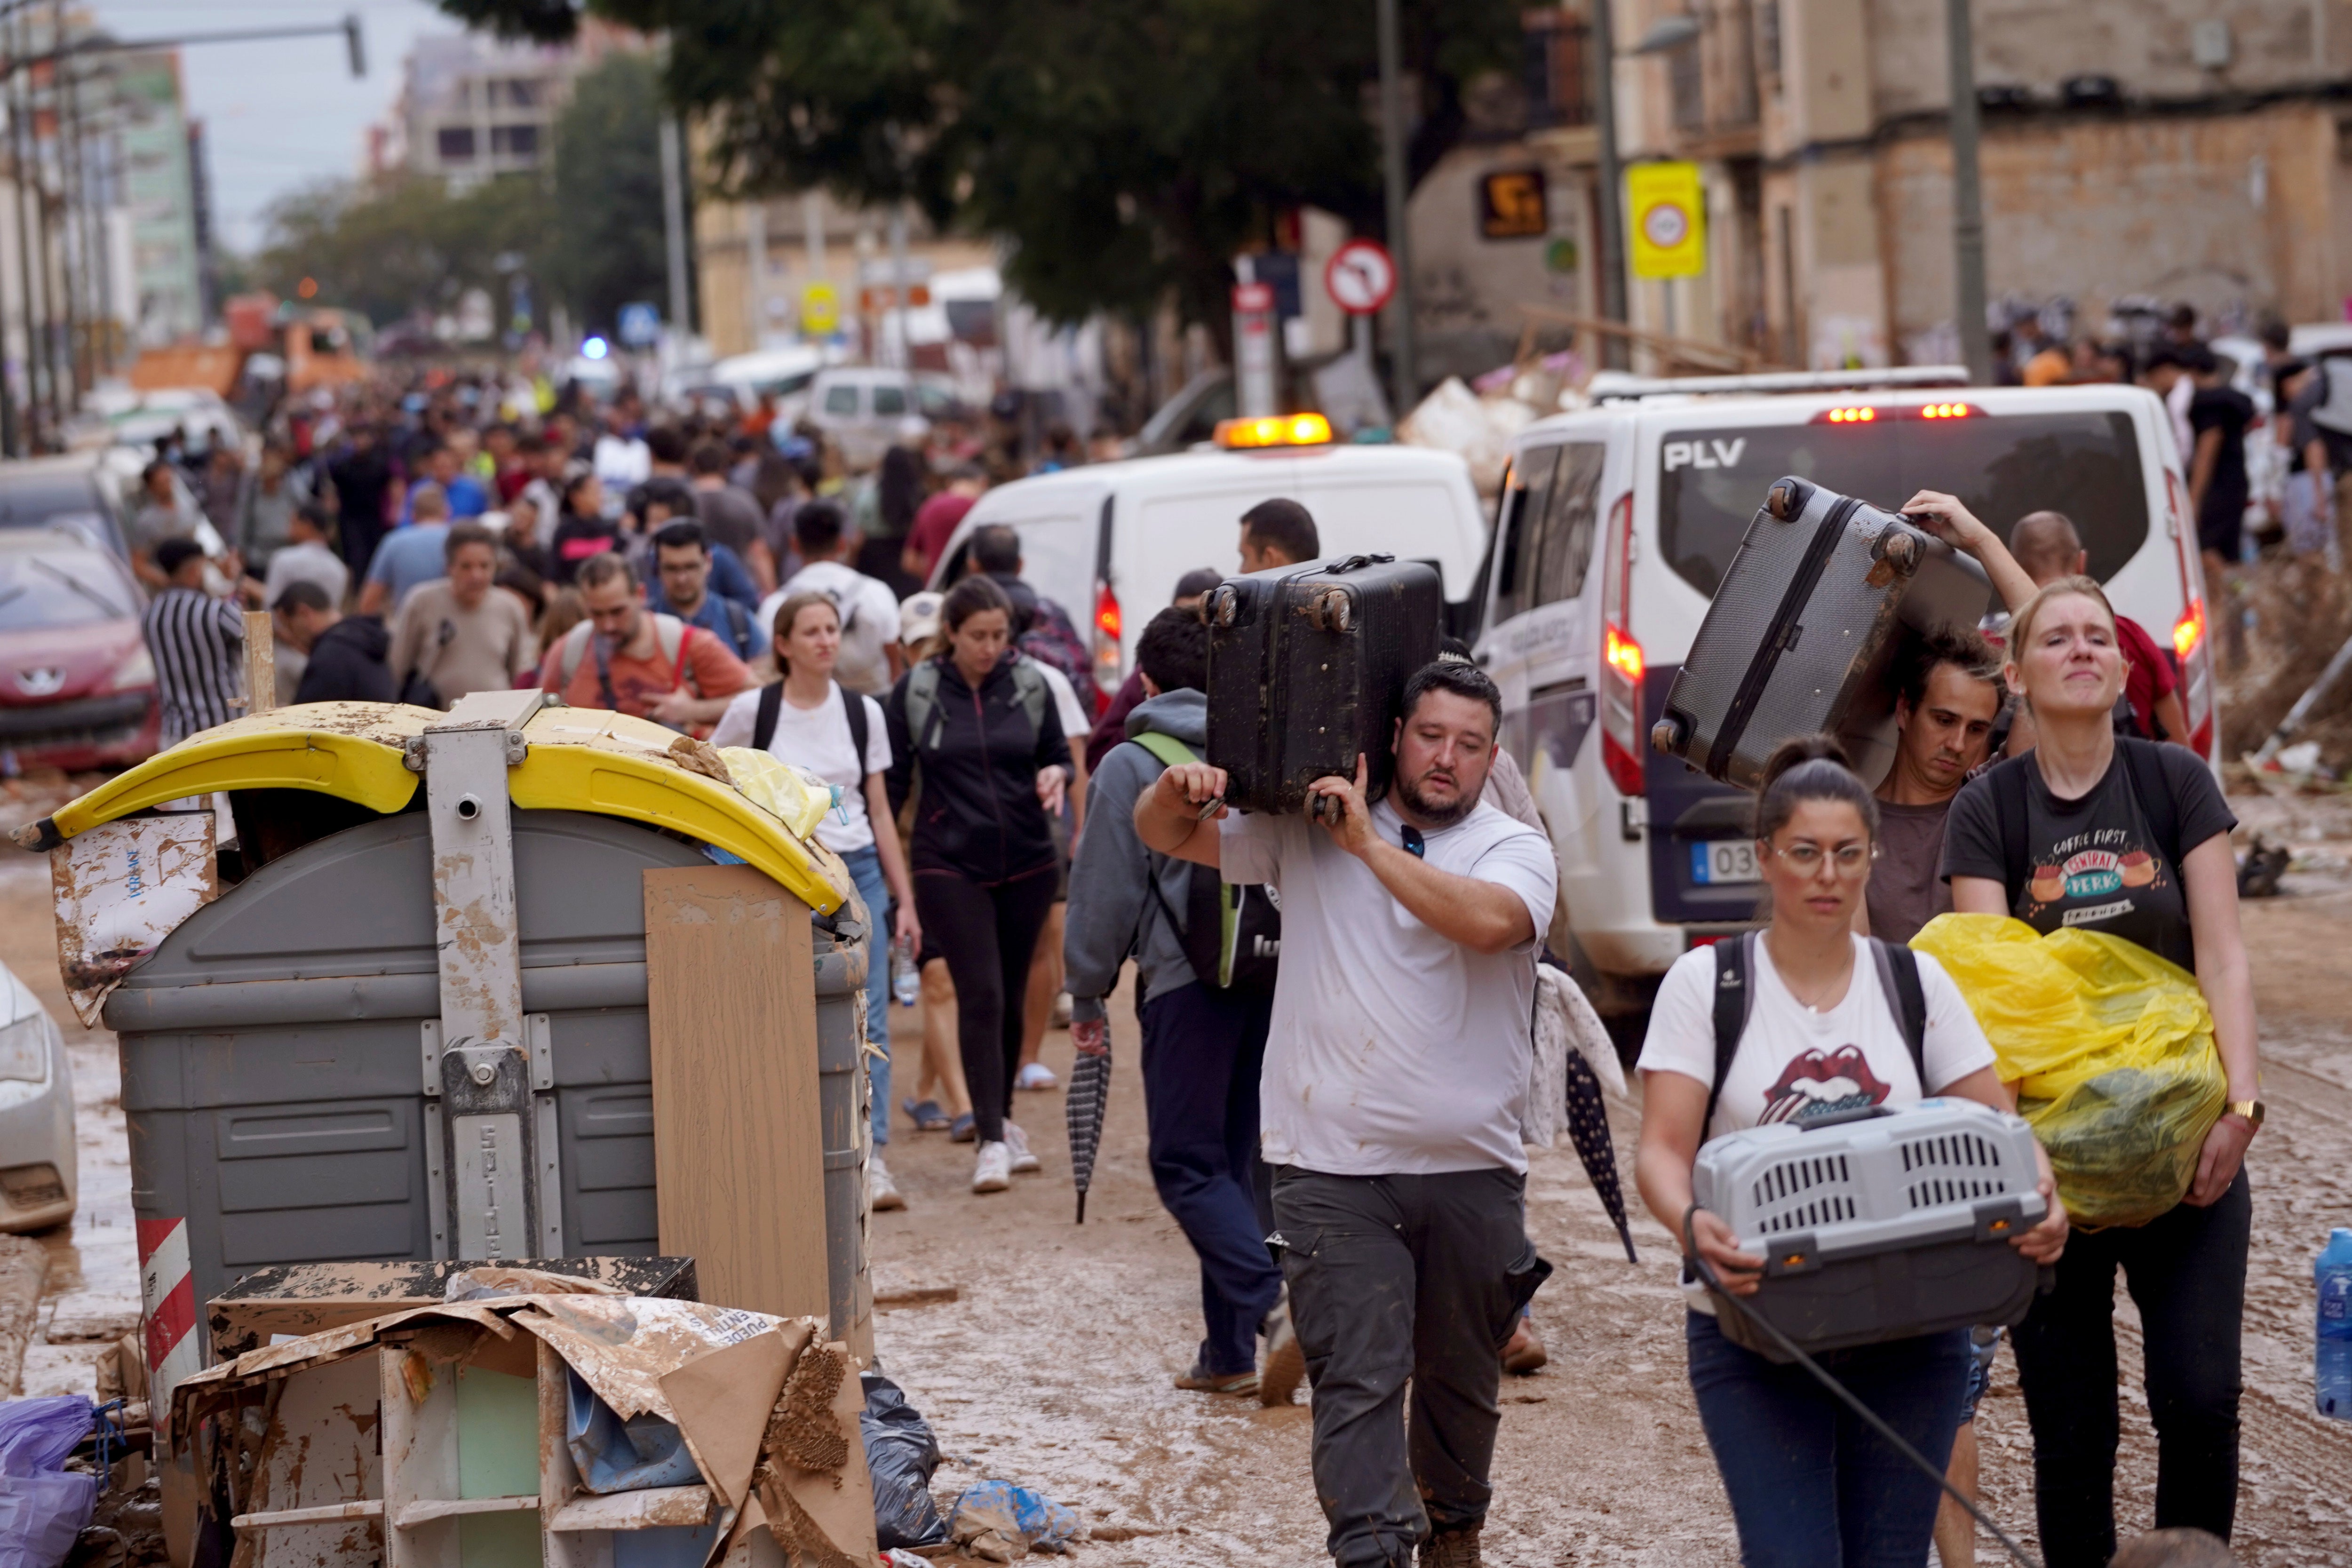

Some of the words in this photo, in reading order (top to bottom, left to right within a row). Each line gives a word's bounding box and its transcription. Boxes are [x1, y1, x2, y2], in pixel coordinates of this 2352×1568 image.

[1663, 438, 1747, 472] PLV
[2053, 831, 2090, 855] COFFEE
[2094, 828, 2128, 845] FIRST
[2068, 851, 2111, 872] CENTRAL
[2071, 874, 2115, 893] PERK
